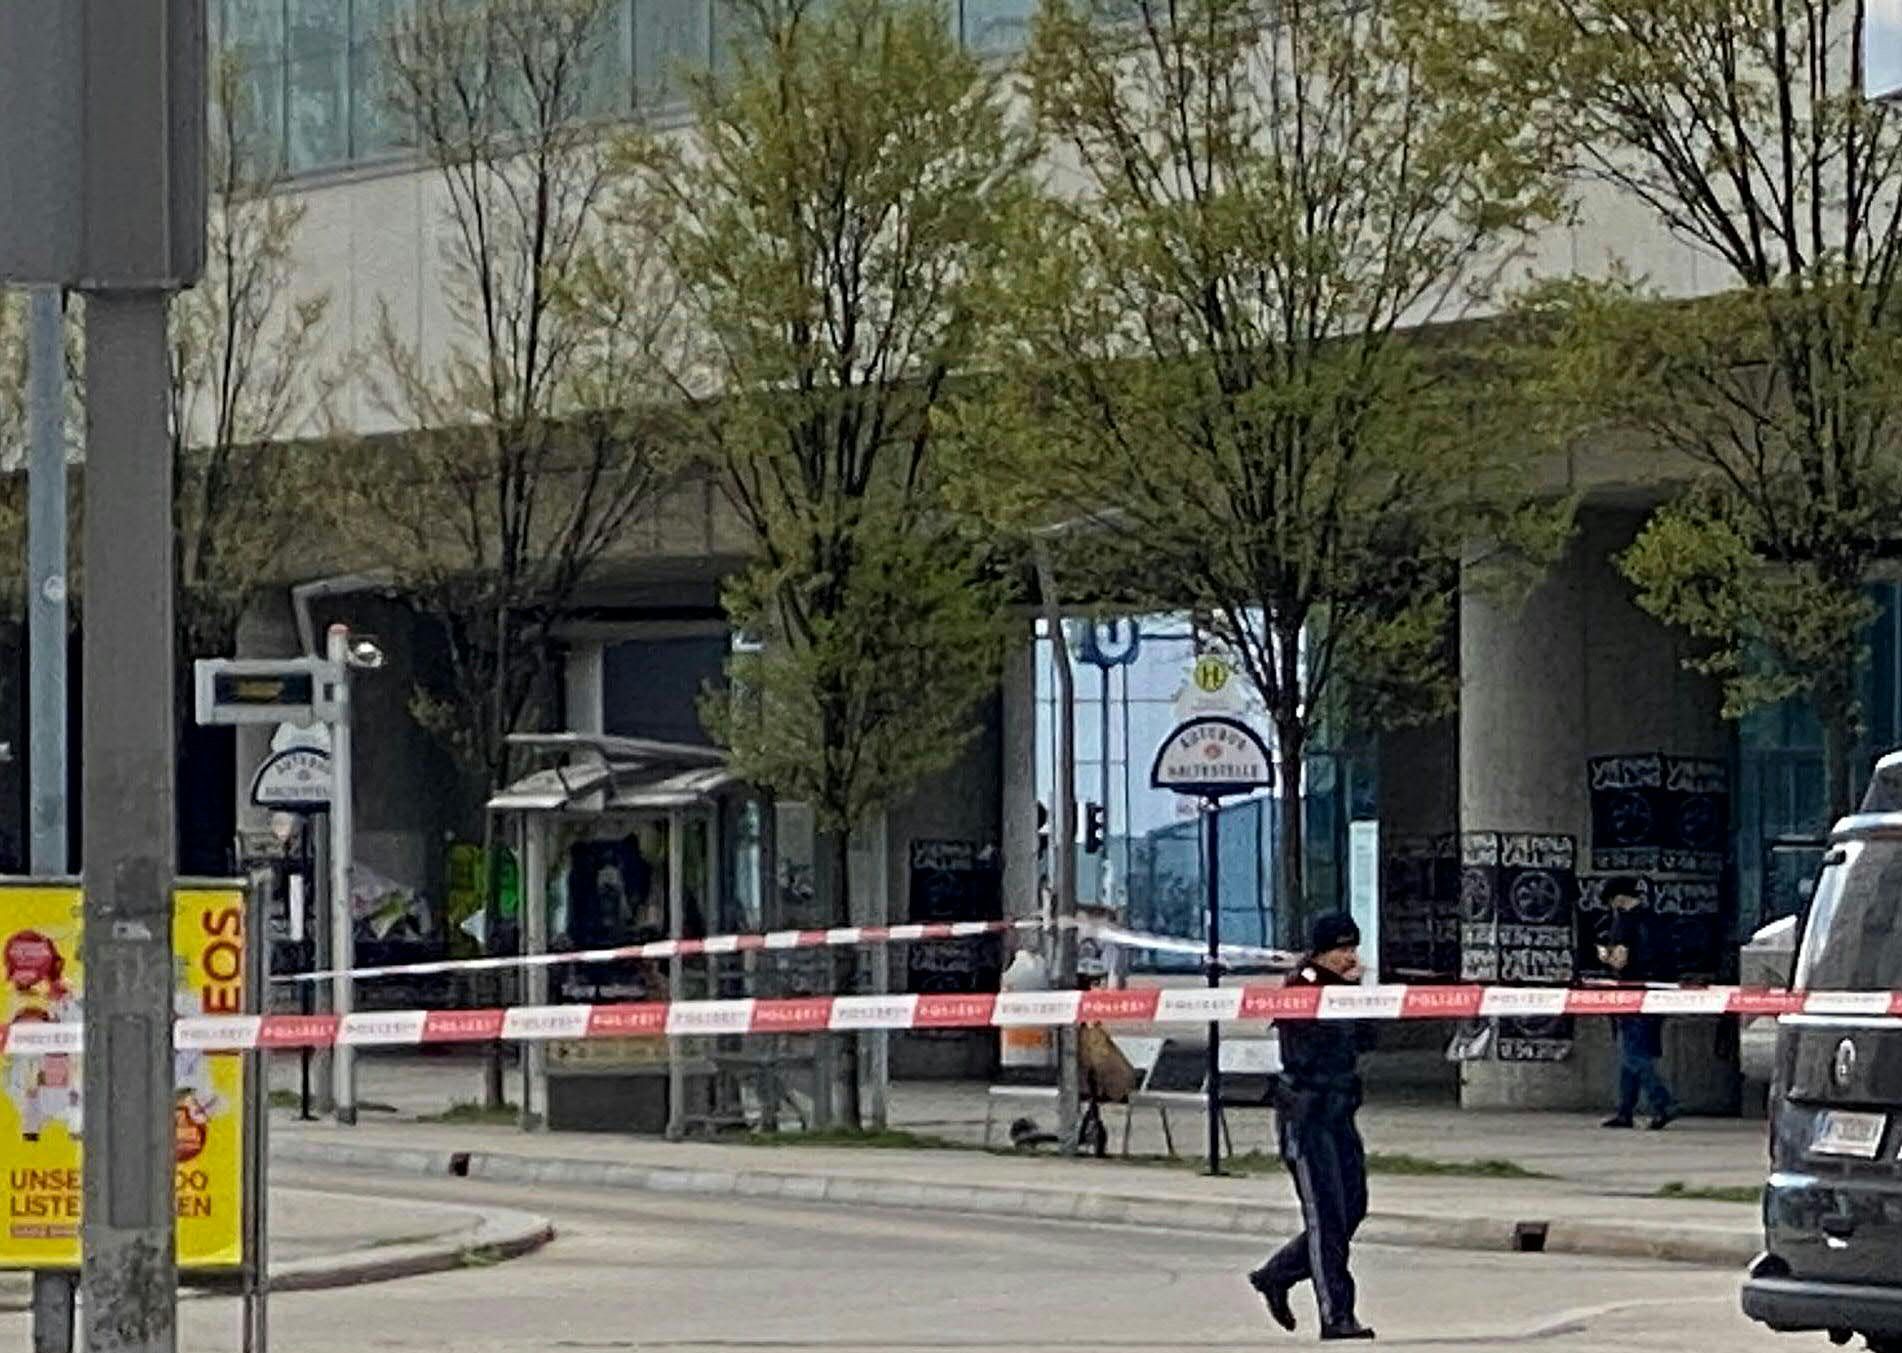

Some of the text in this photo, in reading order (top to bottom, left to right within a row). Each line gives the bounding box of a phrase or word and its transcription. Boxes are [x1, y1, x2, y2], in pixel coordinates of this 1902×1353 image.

[1203, 665, 1219, 688] H
[1168, 764, 1258, 778] HALTESTELLE
[202, 907, 242, 1056] EOS
[1245, 997, 1316, 1011] POLIZEI
[1408, 993, 1478, 1008] POLIZEI
[11, 1168, 81, 1190] UNSE
